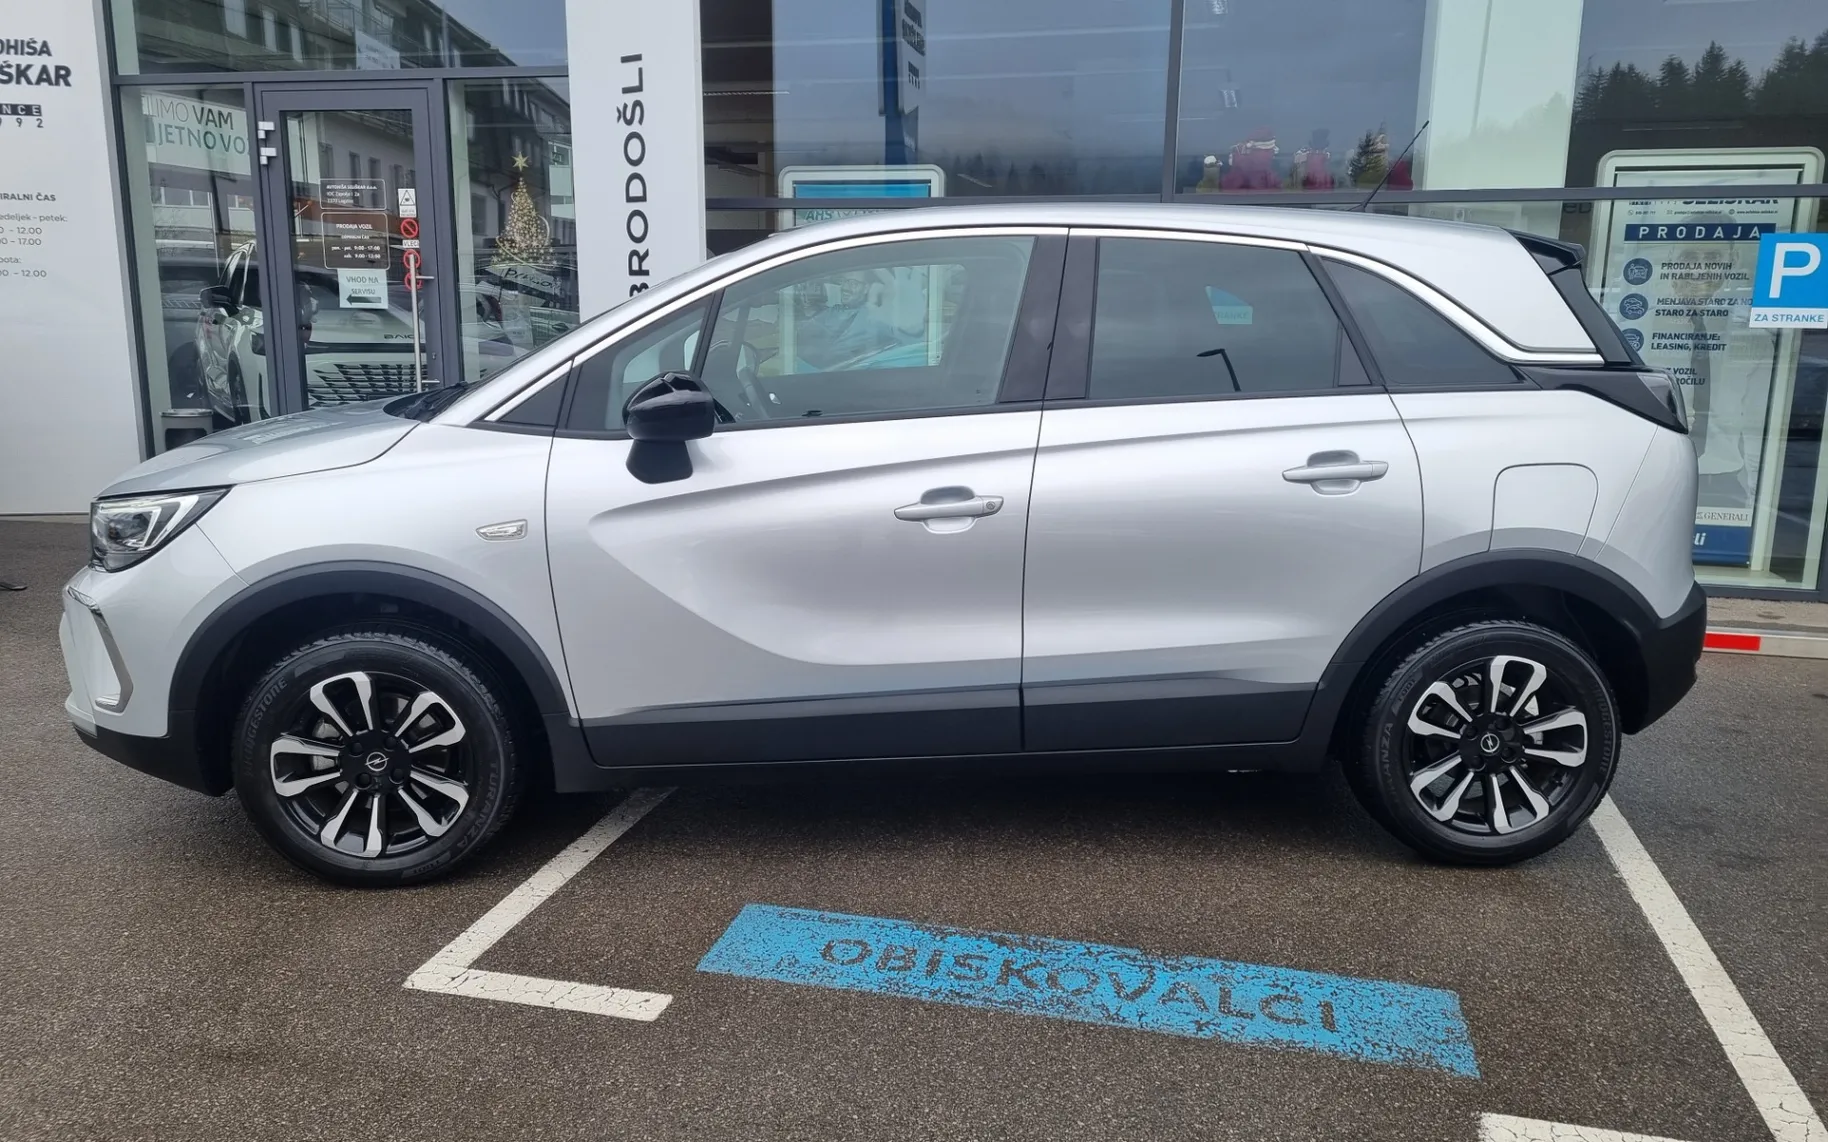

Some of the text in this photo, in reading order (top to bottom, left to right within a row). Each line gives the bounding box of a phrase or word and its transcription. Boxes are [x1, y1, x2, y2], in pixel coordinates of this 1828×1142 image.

[0, 60, 72, 87] ŠKAR
[192, 104, 234, 130] VAM
[0, 117, 44, 128] 92
[36, 192, 56, 201] ČAS
[16, 227, 43, 235] 12.00
[1638, 226, 1760, 238] PRODAJA
[21, 270, 47, 278] 12.00
[1768, 242, 1821, 298] P
[346, 276, 379, 284] VHOD NA
[1657, 297, 1697, 306] MENJAVA
[1698, 297, 1726, 306] STARO
[1727, 297, 1738, 306] ZA
[1754, 313, 1825, 323] ZA STRANKE
[1652, 332, 1721, 341] FINANCIRANJE:
[1651, 342, 1727, 351] LEASING, KREDIT
[1673, 367, 1697, 375] VOZIL
[1703, 511, 1749, 521] GENERALI
[820, 938, 1336, 1033] OBISKOVALCI
